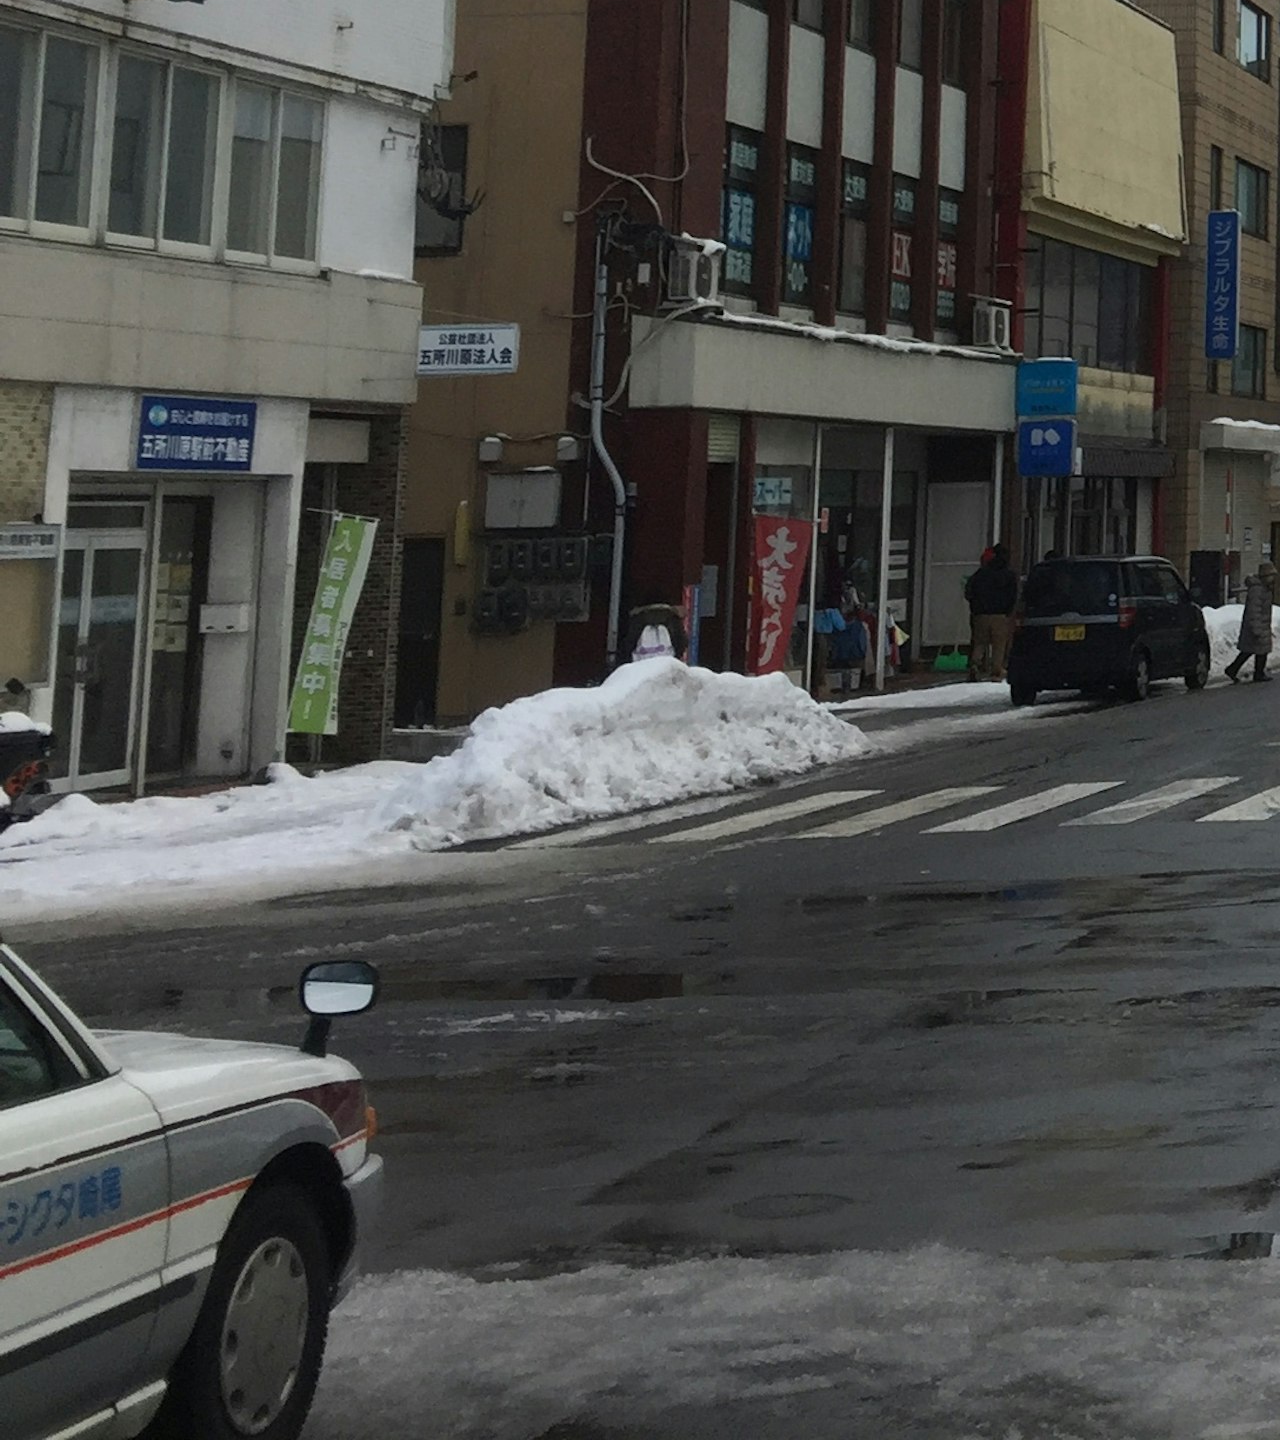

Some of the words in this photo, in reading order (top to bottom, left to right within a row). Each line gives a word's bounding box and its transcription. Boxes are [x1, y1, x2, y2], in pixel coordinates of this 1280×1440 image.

[1212, 220, 1232, 350] ジブラルタ生命
[419, 347, 513, 366] 五所川原法人会
